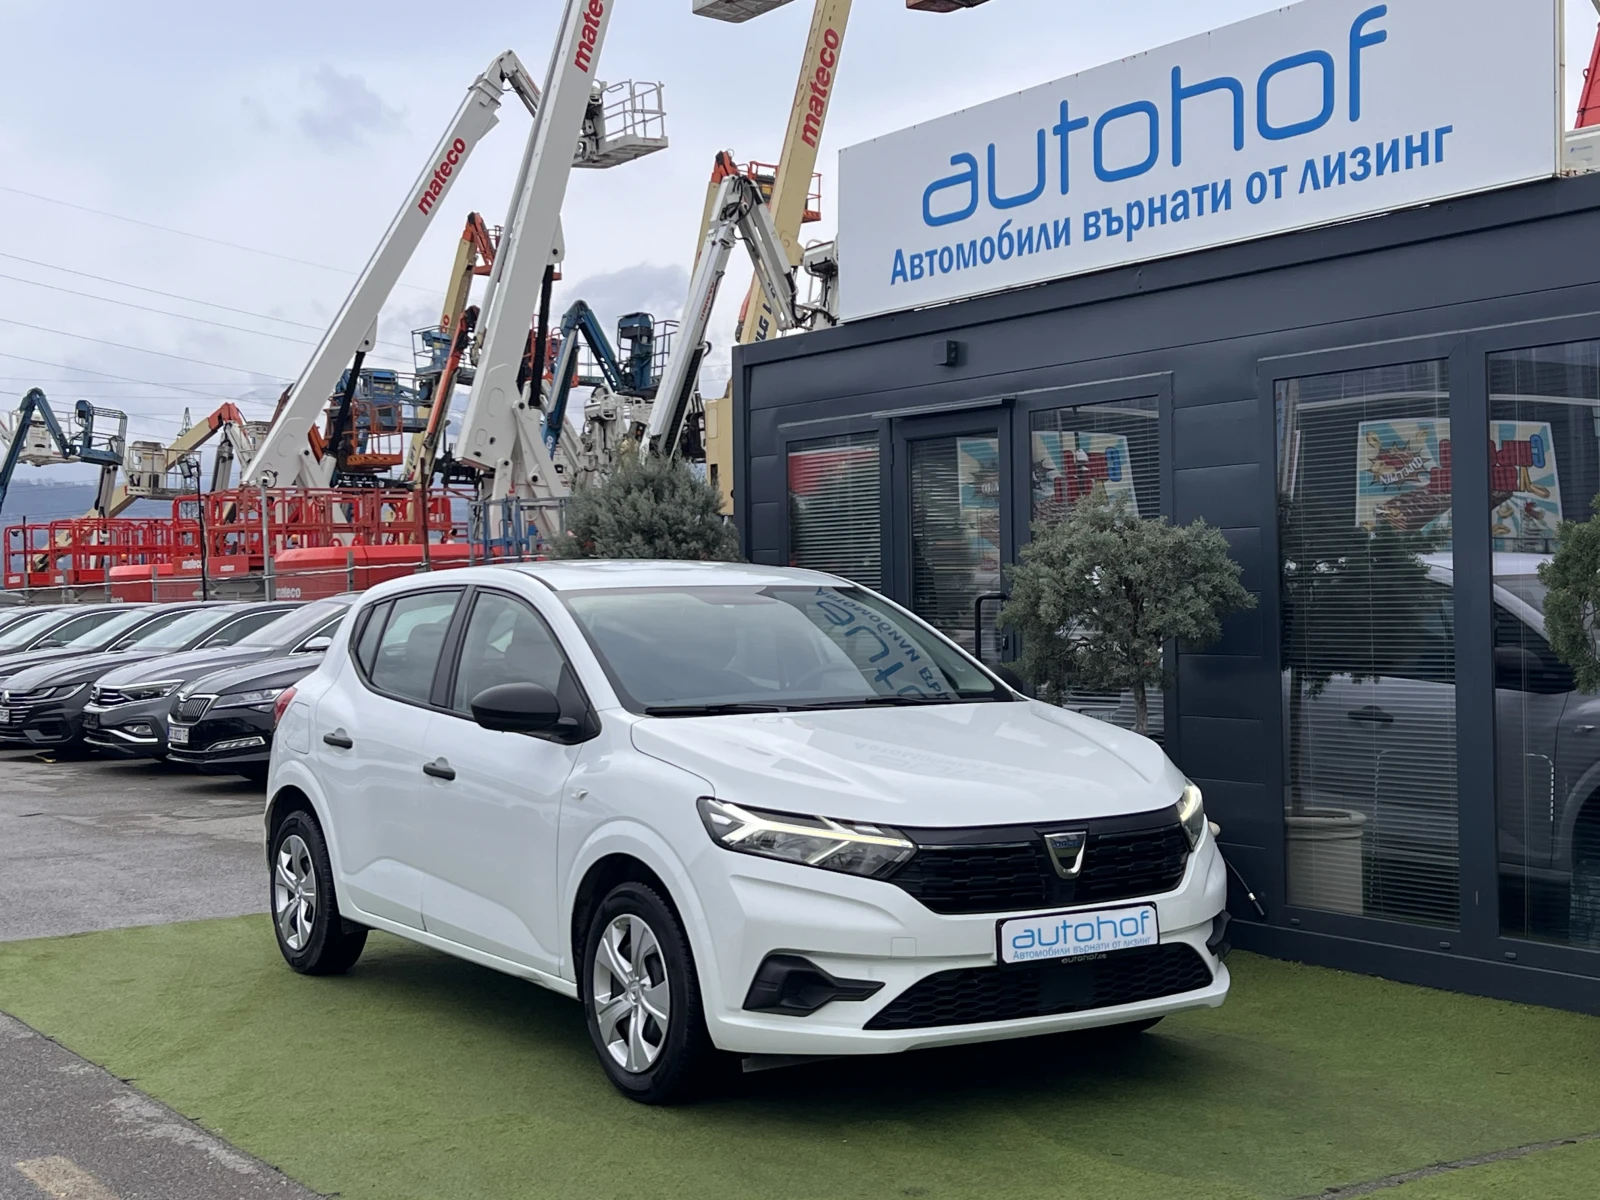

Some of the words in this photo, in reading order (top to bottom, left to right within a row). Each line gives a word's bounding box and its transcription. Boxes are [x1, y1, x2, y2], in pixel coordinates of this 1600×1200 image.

[574, 0, 603, 73] mate
[801, 28, 839, 149] mateco
[922, 4, 1388, 227] autohof
[418, 138, 466, 216] mateco
[890, 217, 1071, 285] Автомобили
[1083, 179, 1232, 242] върнати
[1245, 164, 1288, 205] от
[1298, 124, 1453, 194] лизинг
[1012, 910, 1149, 949] autohof
[1013, 946, 1071, 960] Автомобили
[1073, 942, 1110, 955] върнати
[1112, 940, 1121, 949] от
[1123, 936, 1151, 947] лизинг
